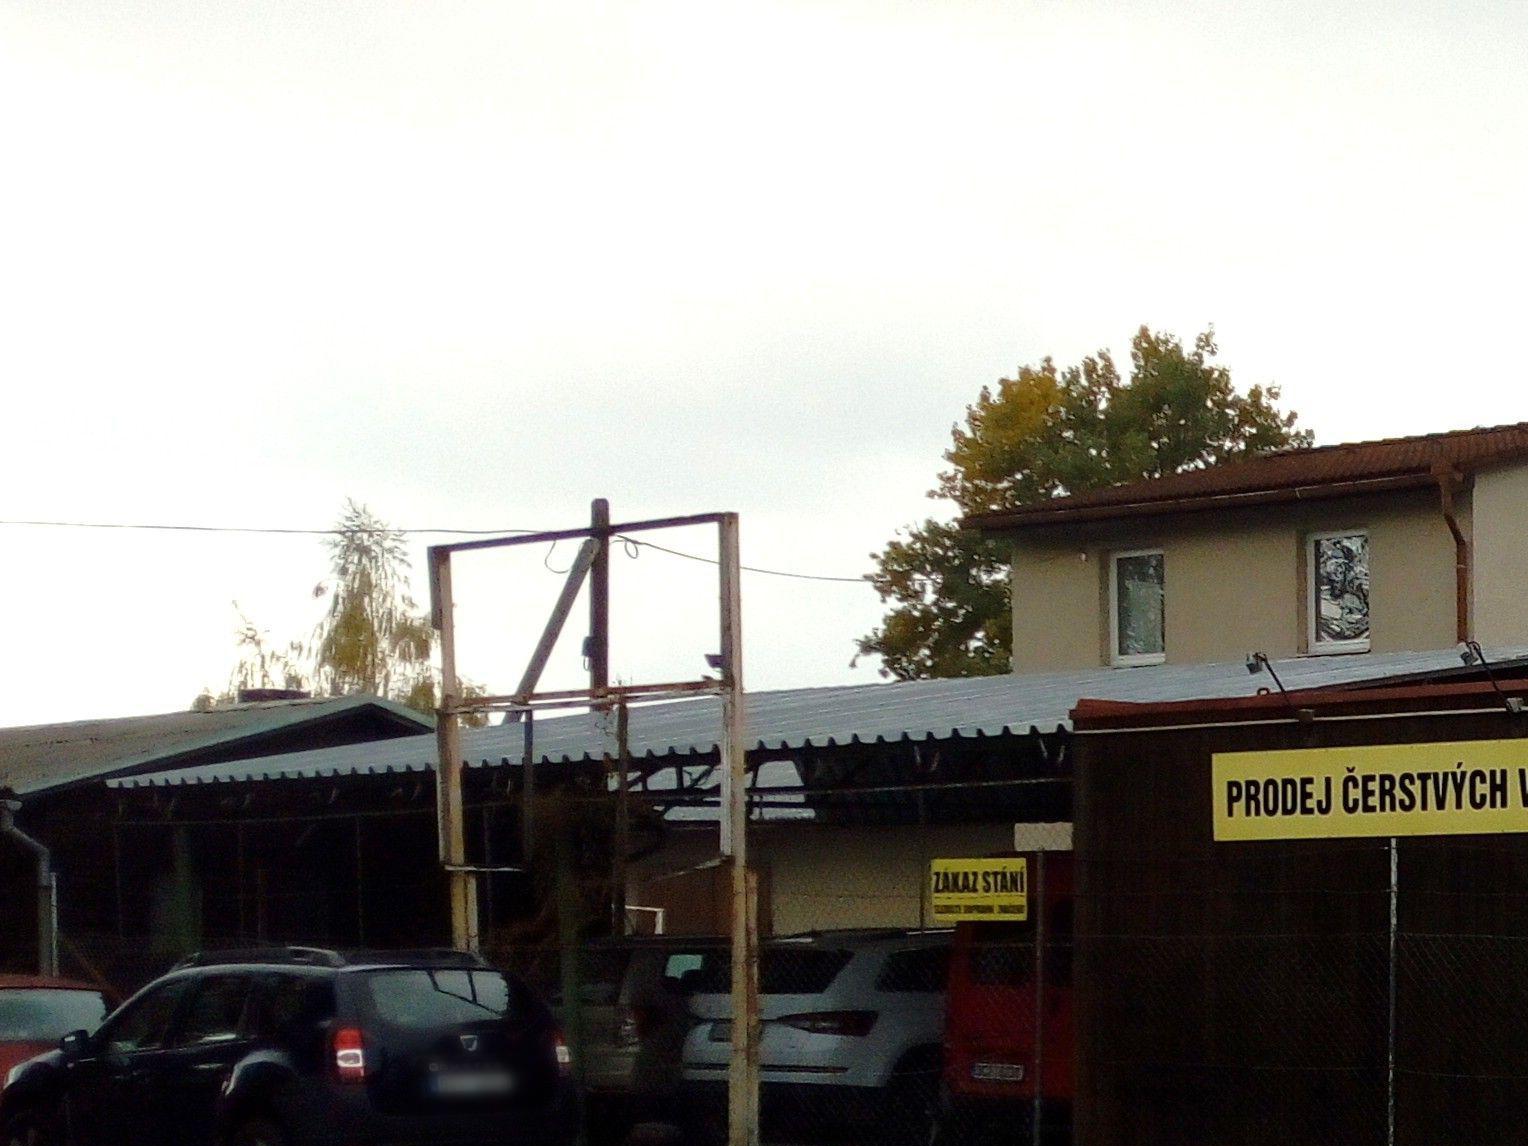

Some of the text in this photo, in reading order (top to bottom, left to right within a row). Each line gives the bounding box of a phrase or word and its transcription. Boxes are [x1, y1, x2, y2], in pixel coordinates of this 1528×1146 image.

[1226, 775, 1332, 818] PRODEJ
[1341, 762, 1508, 814] ČERSTVÝCH
[933, 865, 1025, 893] ZÁKAZ STÁNÍ
